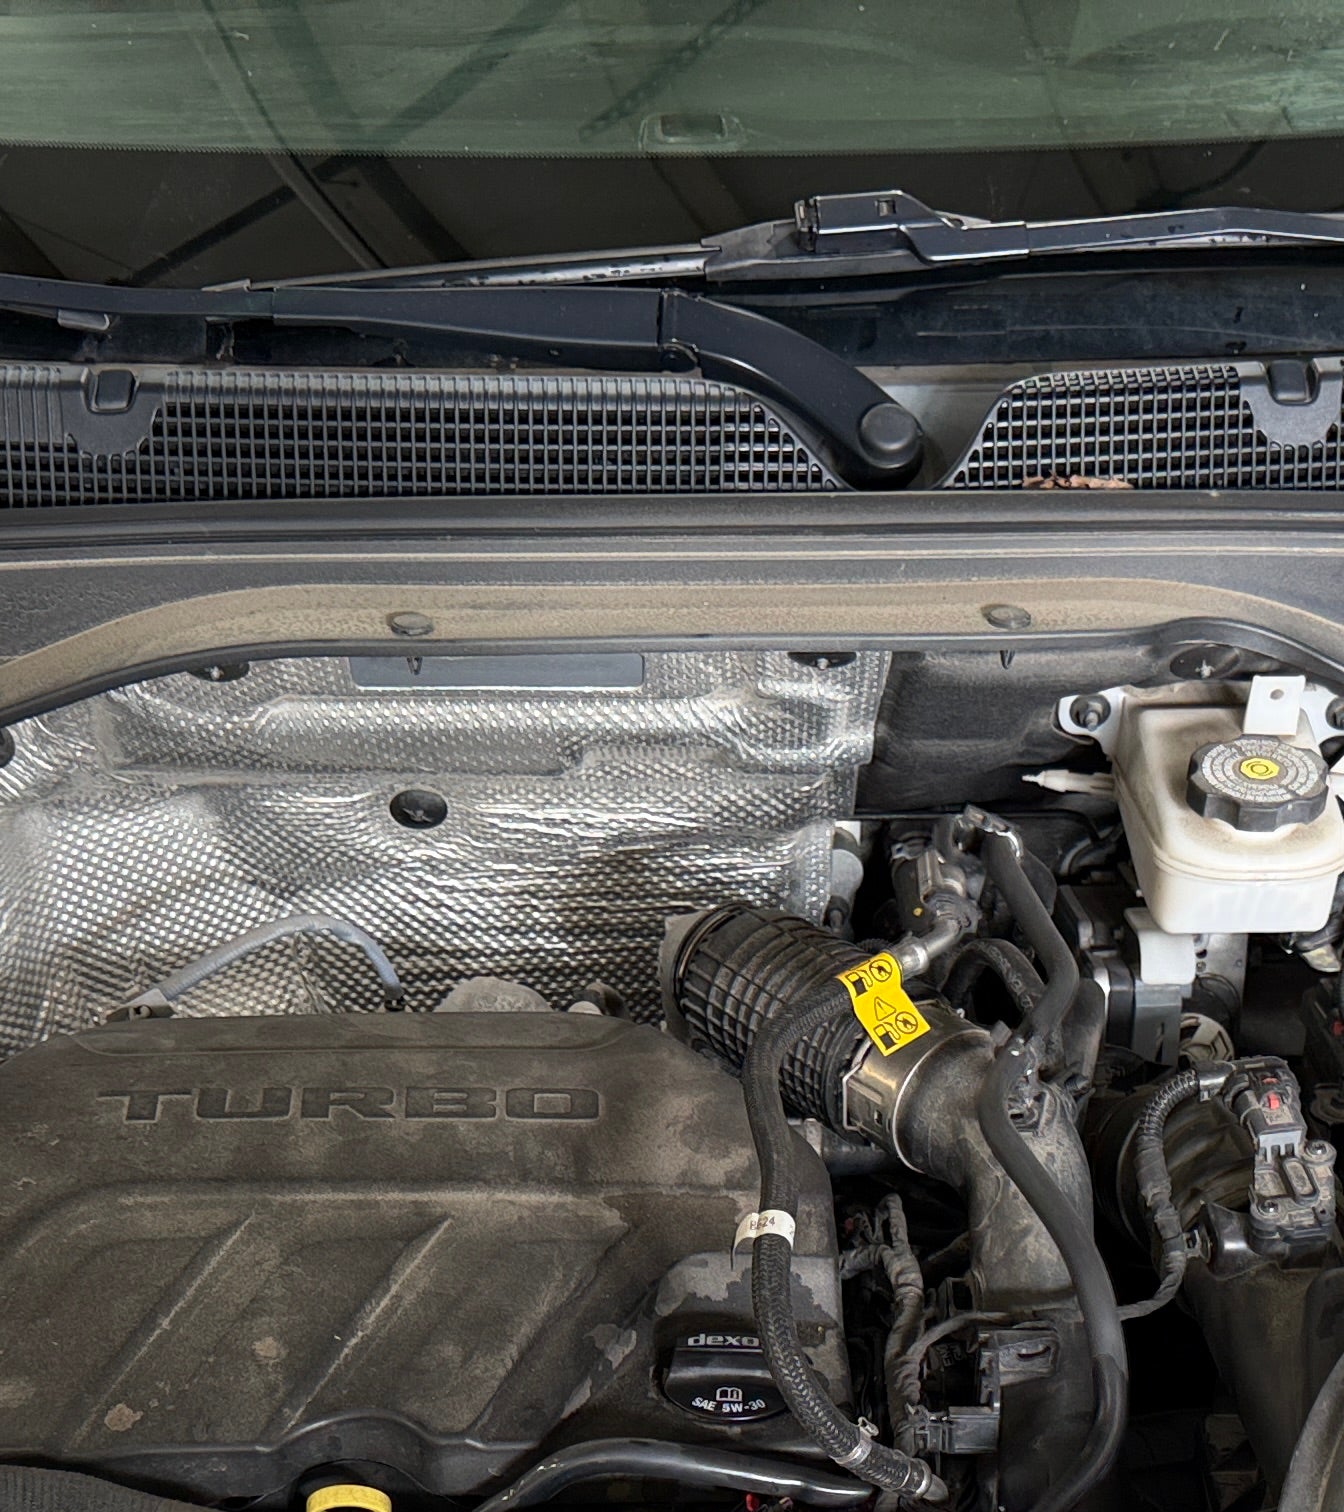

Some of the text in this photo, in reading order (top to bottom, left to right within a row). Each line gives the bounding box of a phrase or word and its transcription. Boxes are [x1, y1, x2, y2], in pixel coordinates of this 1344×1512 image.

[96, 1085, 601, 1123] TURBO
[687, 1333, 760, 1346] dexo
[691, 1397, 766, 1413] SAE 5W-30
